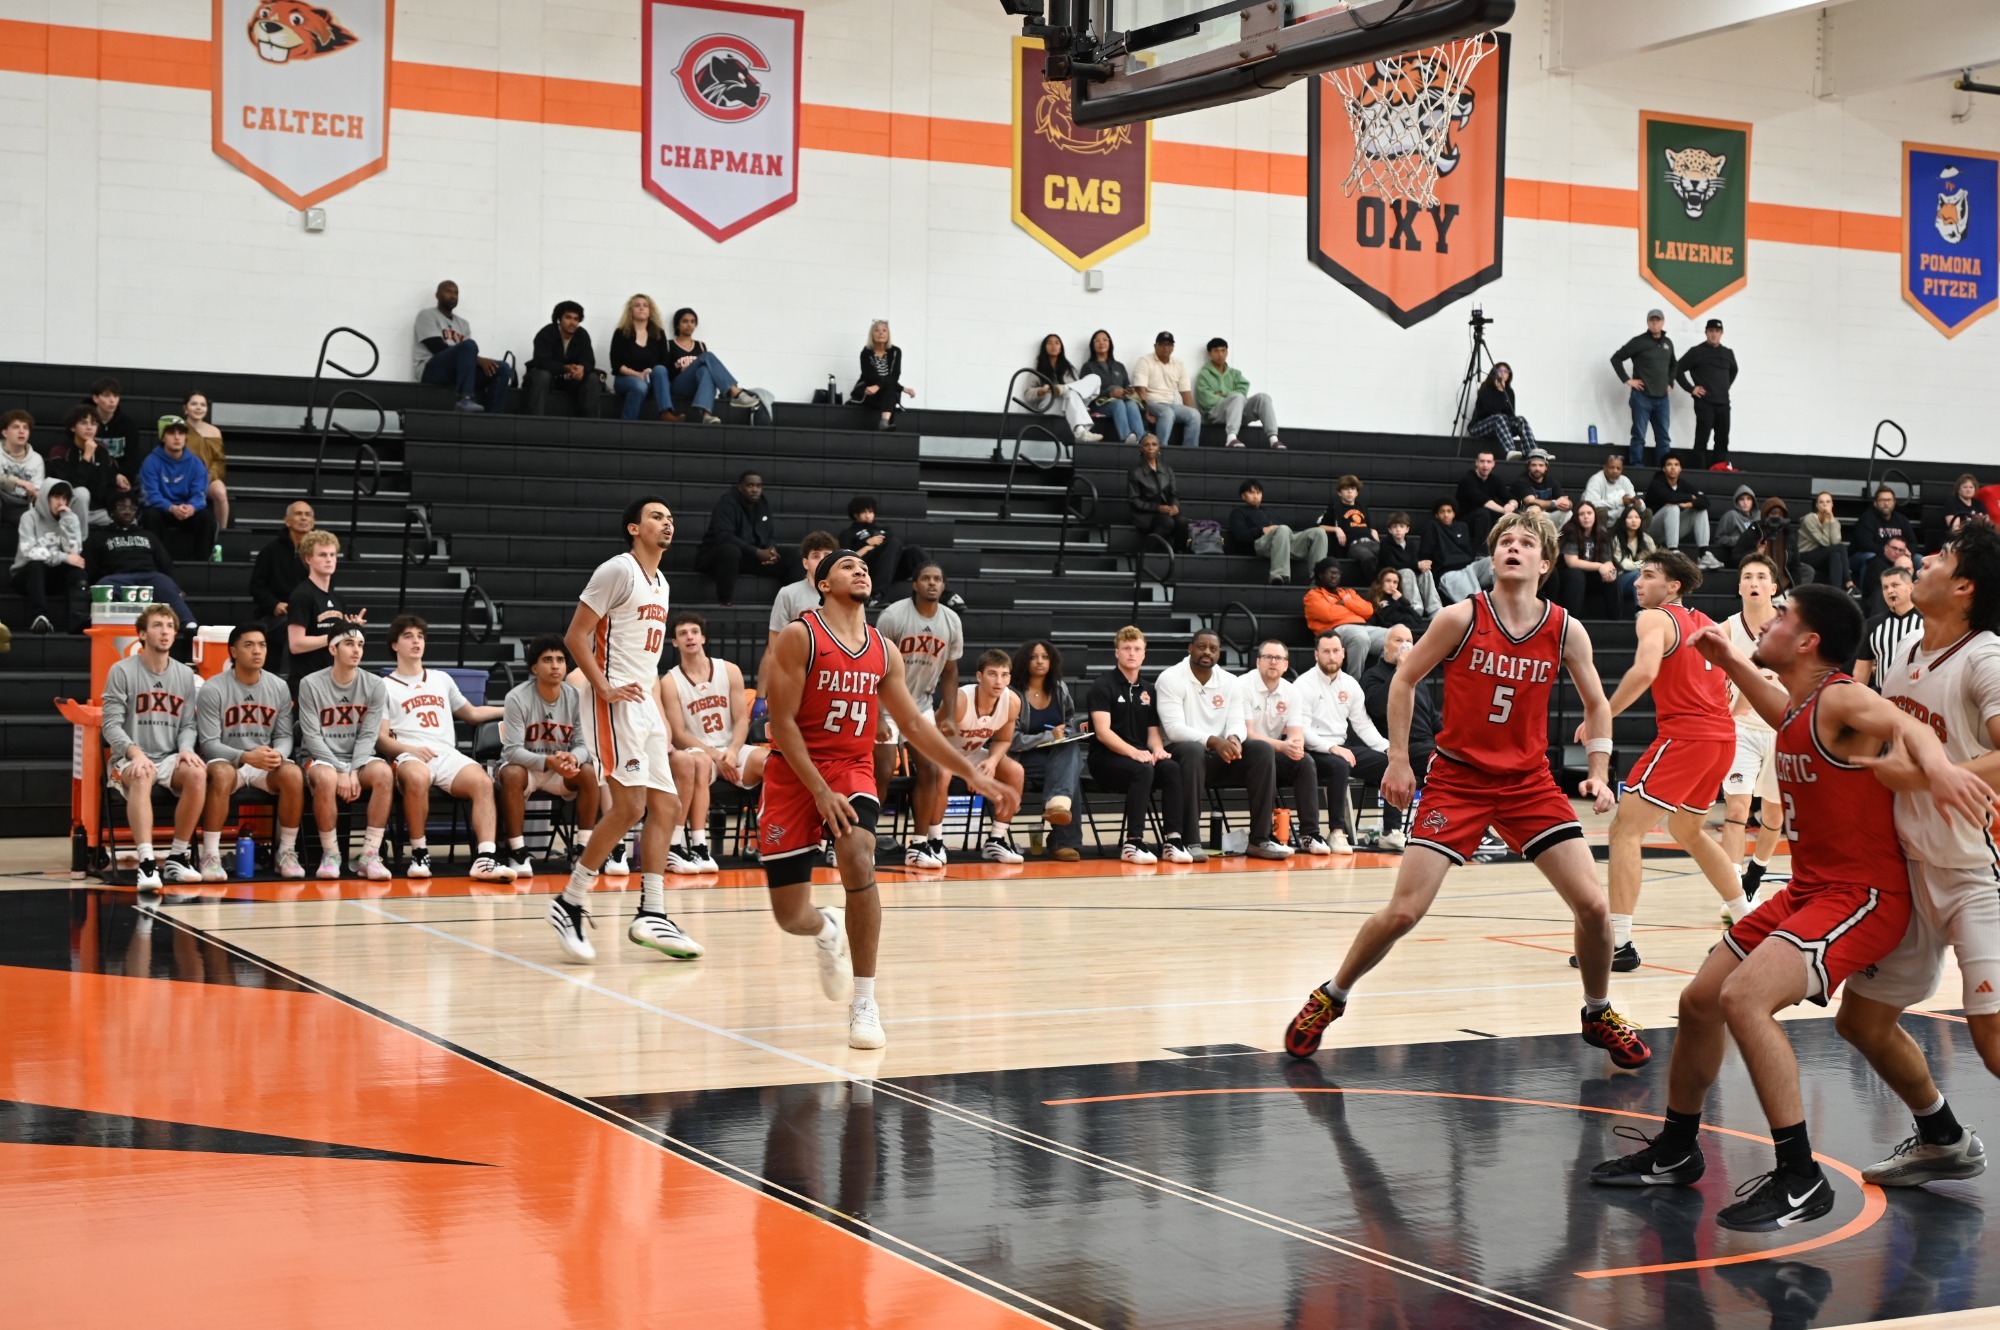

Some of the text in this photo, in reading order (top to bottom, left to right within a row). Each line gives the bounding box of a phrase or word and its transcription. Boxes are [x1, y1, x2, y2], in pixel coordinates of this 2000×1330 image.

[242, 105, 364, 139] CALTECH
[660, 144, 783, 177] CHAPMAN
[1044, 174, 1121, 215] CMS
[1357, 196, 1459, 253] OXY
[1655, 240, 1734, 266] LAVERNE
[1920, 253, 1982, 276] POMONA
[1923, 277, 1978, 300] PITZER
[644, 627, 663, 654] 10
[899, 634, 947, 658] OXY
[1468, 647, 1552, 684] PACIFIC
[134, 691, 185, 717] OXY
[224, 703, 278, 728] OXY
[319, 704, 369, 728] OXY
[401, 695, 445, 714] TIGERS
[687, 695, 728, 716] TIGERS
[1488, 685, 1516, 724] 5
[416, 710, 440, 728] 30
[702, 712, 725, 734] 23
[822, 698, 869, 738] 24
[524, 720, 575, 744] OXY
